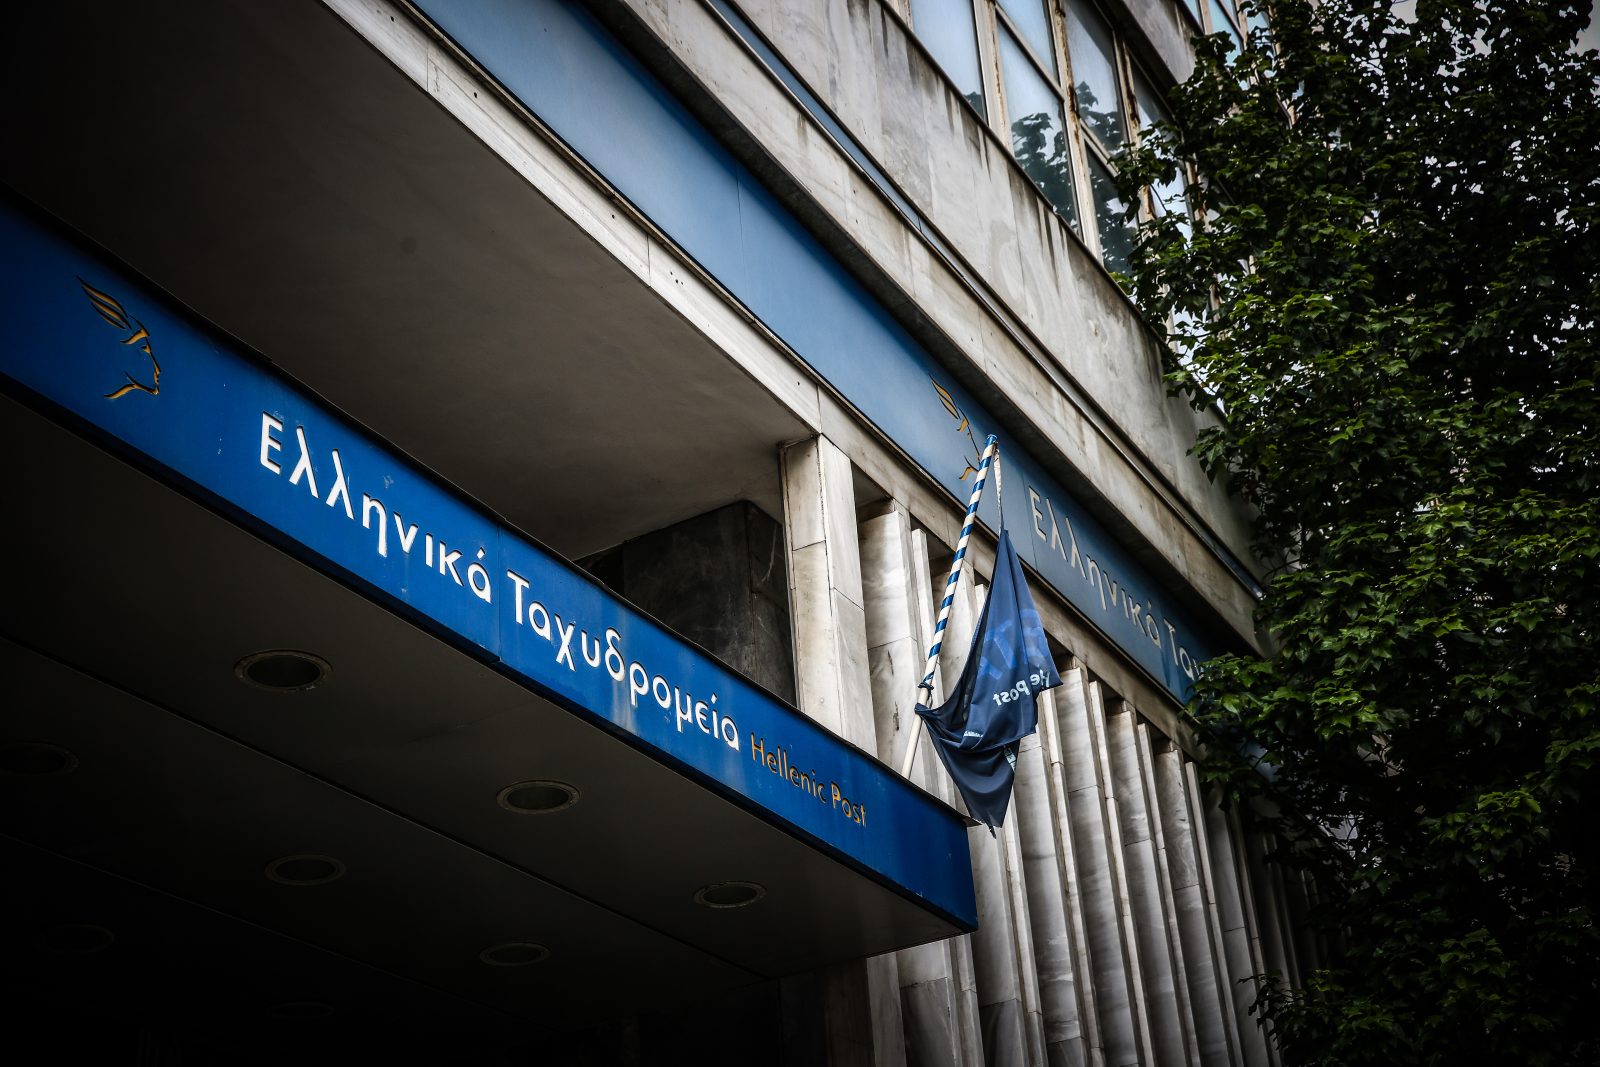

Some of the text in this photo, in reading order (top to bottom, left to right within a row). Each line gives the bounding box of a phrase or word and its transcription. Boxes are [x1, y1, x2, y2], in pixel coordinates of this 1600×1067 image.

[260, 410, 740, 751] Ελληνικά Ταχυδρομεία
[1028, 486, 1161, 649] Ελληνικά
[750, 732, 867, 828] Hellenic Post
